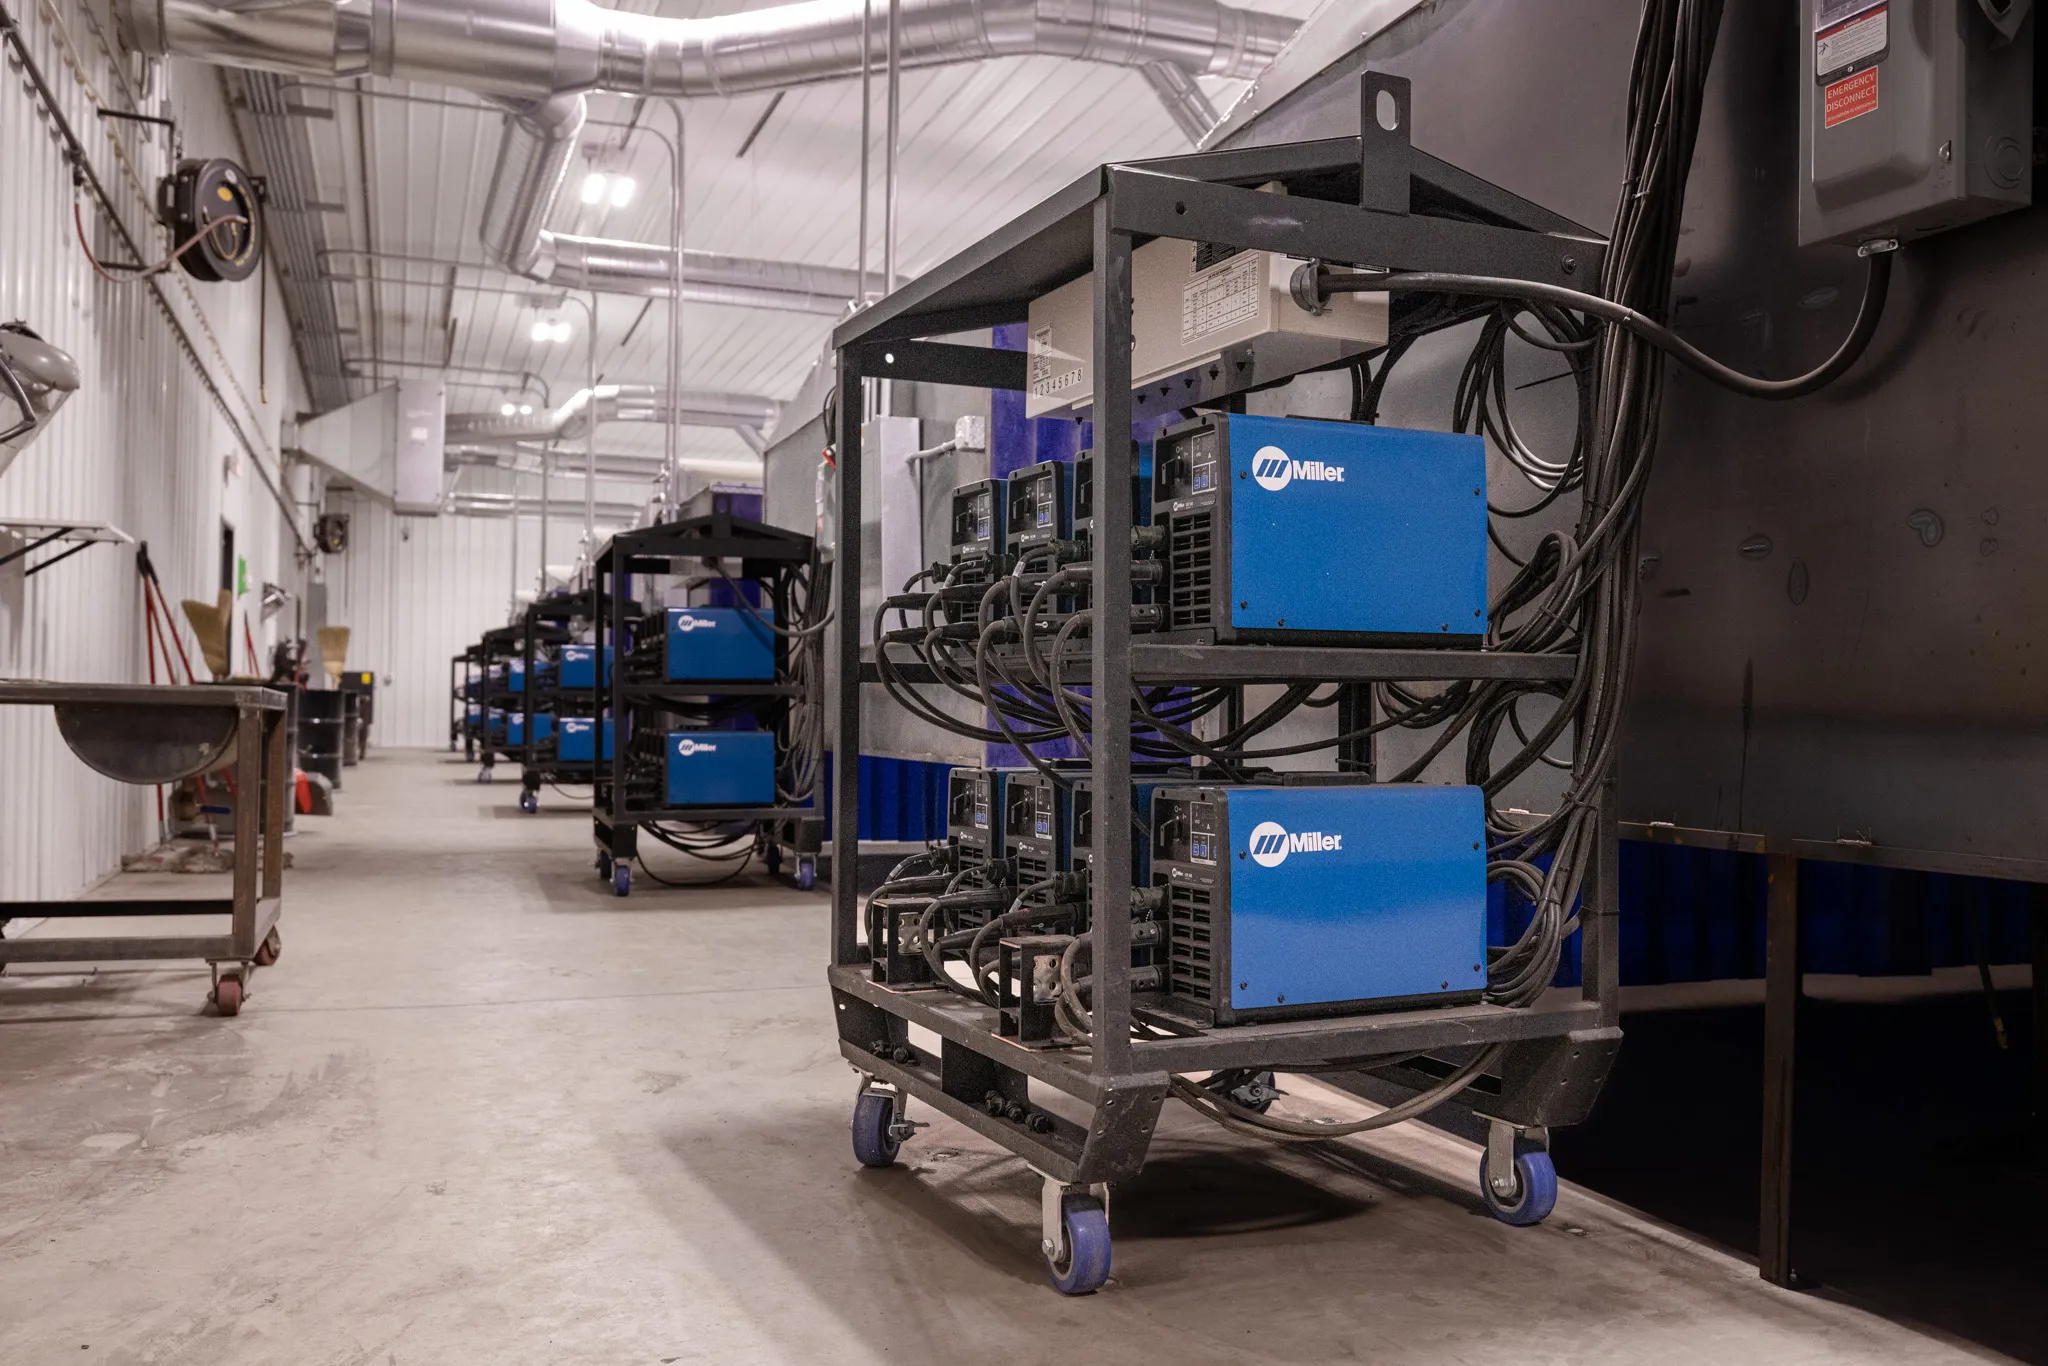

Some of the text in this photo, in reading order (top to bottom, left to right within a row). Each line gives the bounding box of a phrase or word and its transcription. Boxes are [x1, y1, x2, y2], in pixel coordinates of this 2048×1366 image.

[1826, 84, 1876, 112] DISCONNECT
[1827, 72, 1875, 99] EMERGENCY
[1292, 459, 1345, 482] Miller
[1289, 831, 1342, 853] Miller
